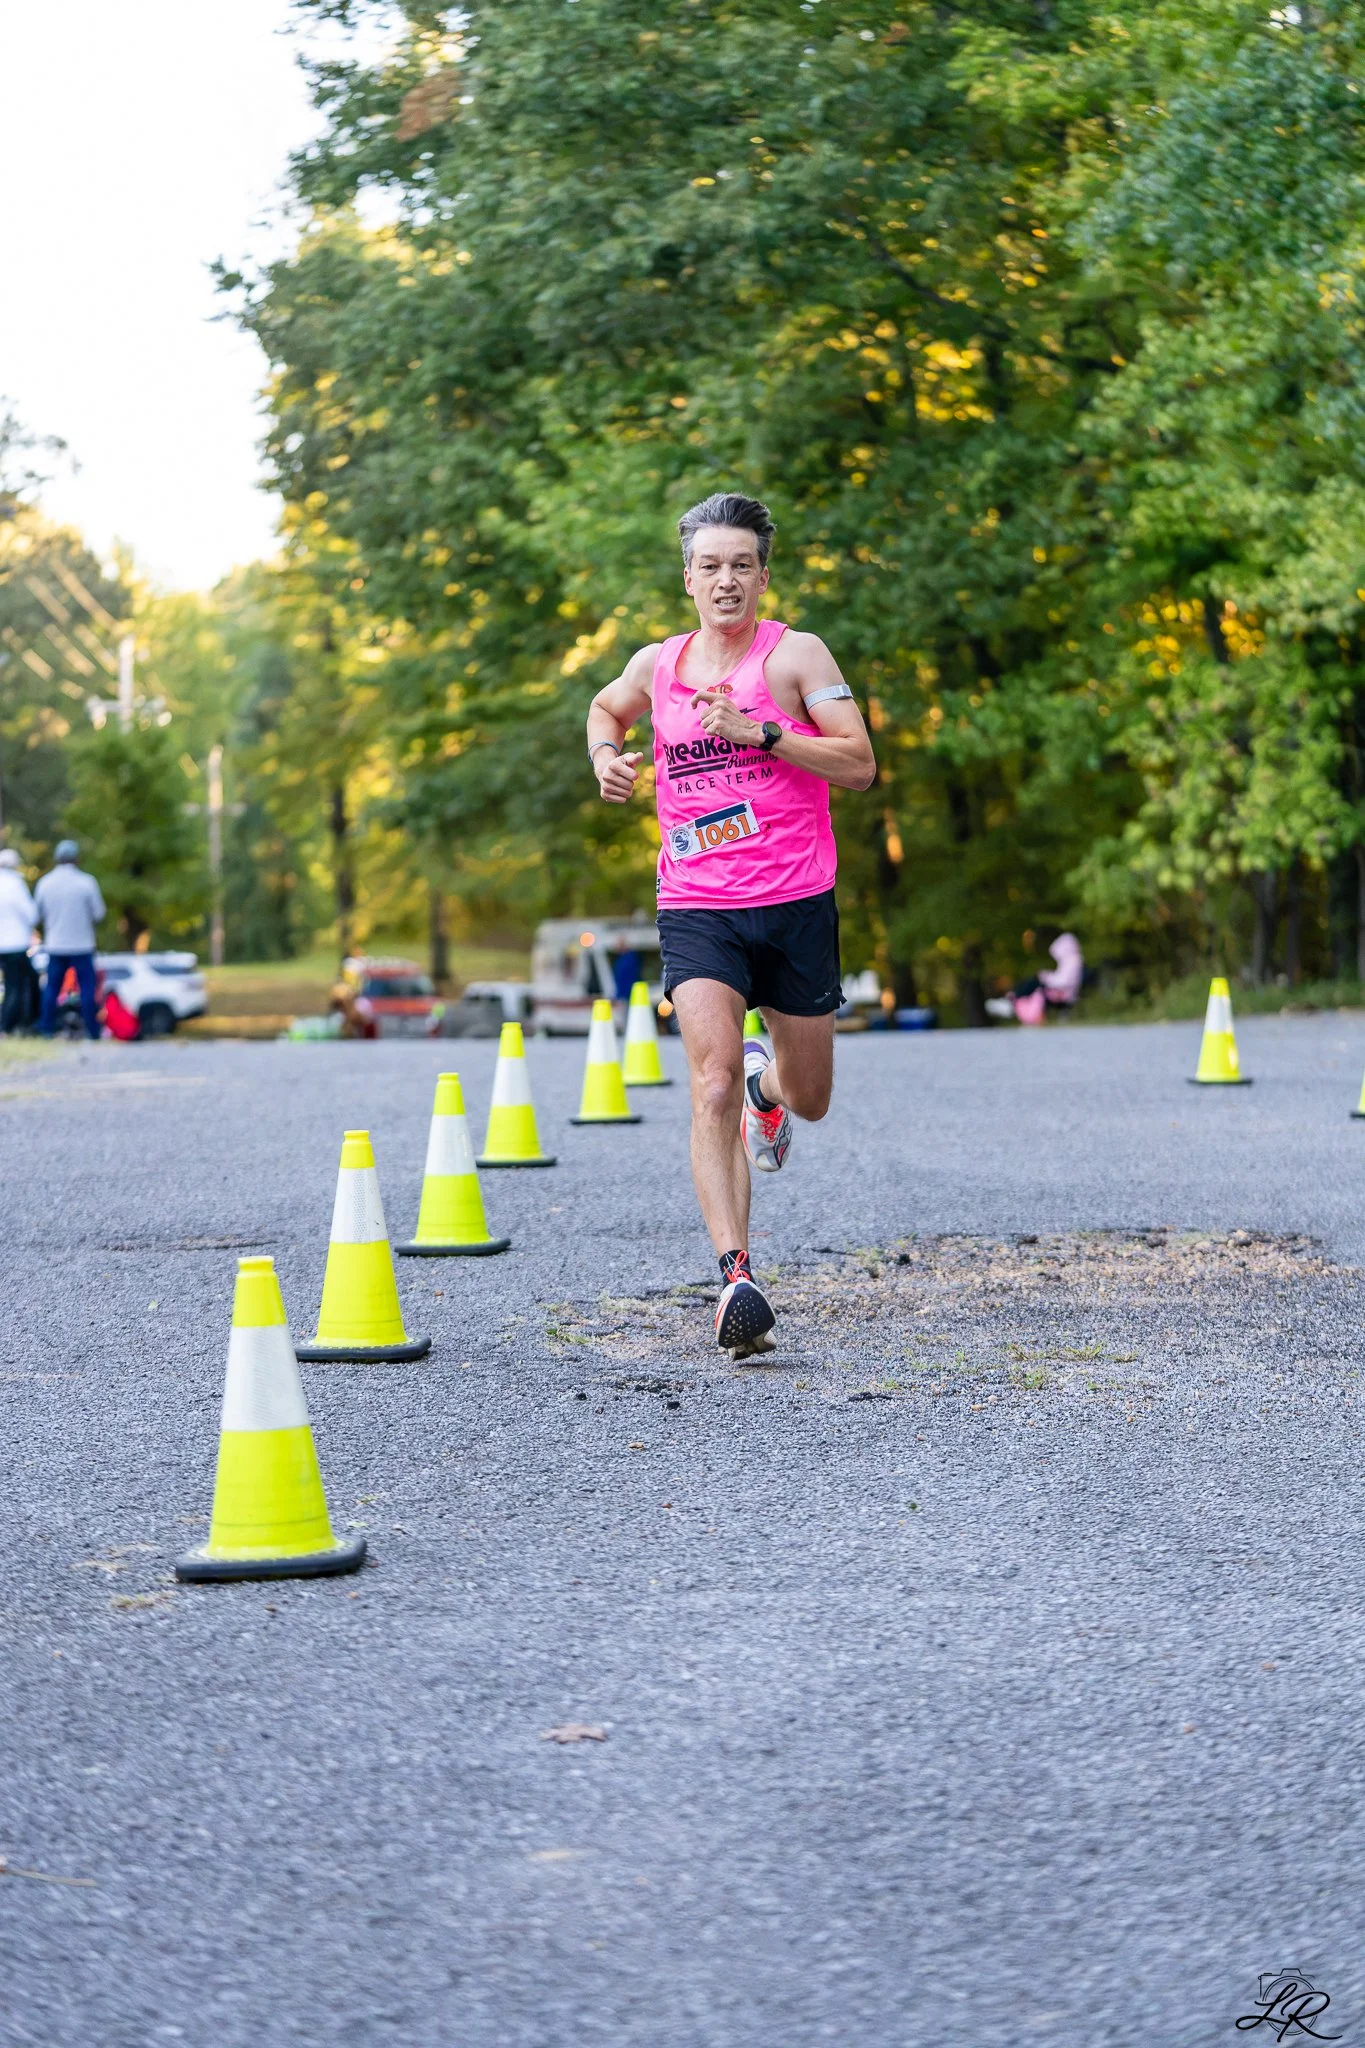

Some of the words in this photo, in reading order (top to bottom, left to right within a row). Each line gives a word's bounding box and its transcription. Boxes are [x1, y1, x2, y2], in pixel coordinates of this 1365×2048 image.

[677, 777, 716, 794] RACE
[725, 766, 773, 785] TEAM
[695, 814, 751, 850] 1061
